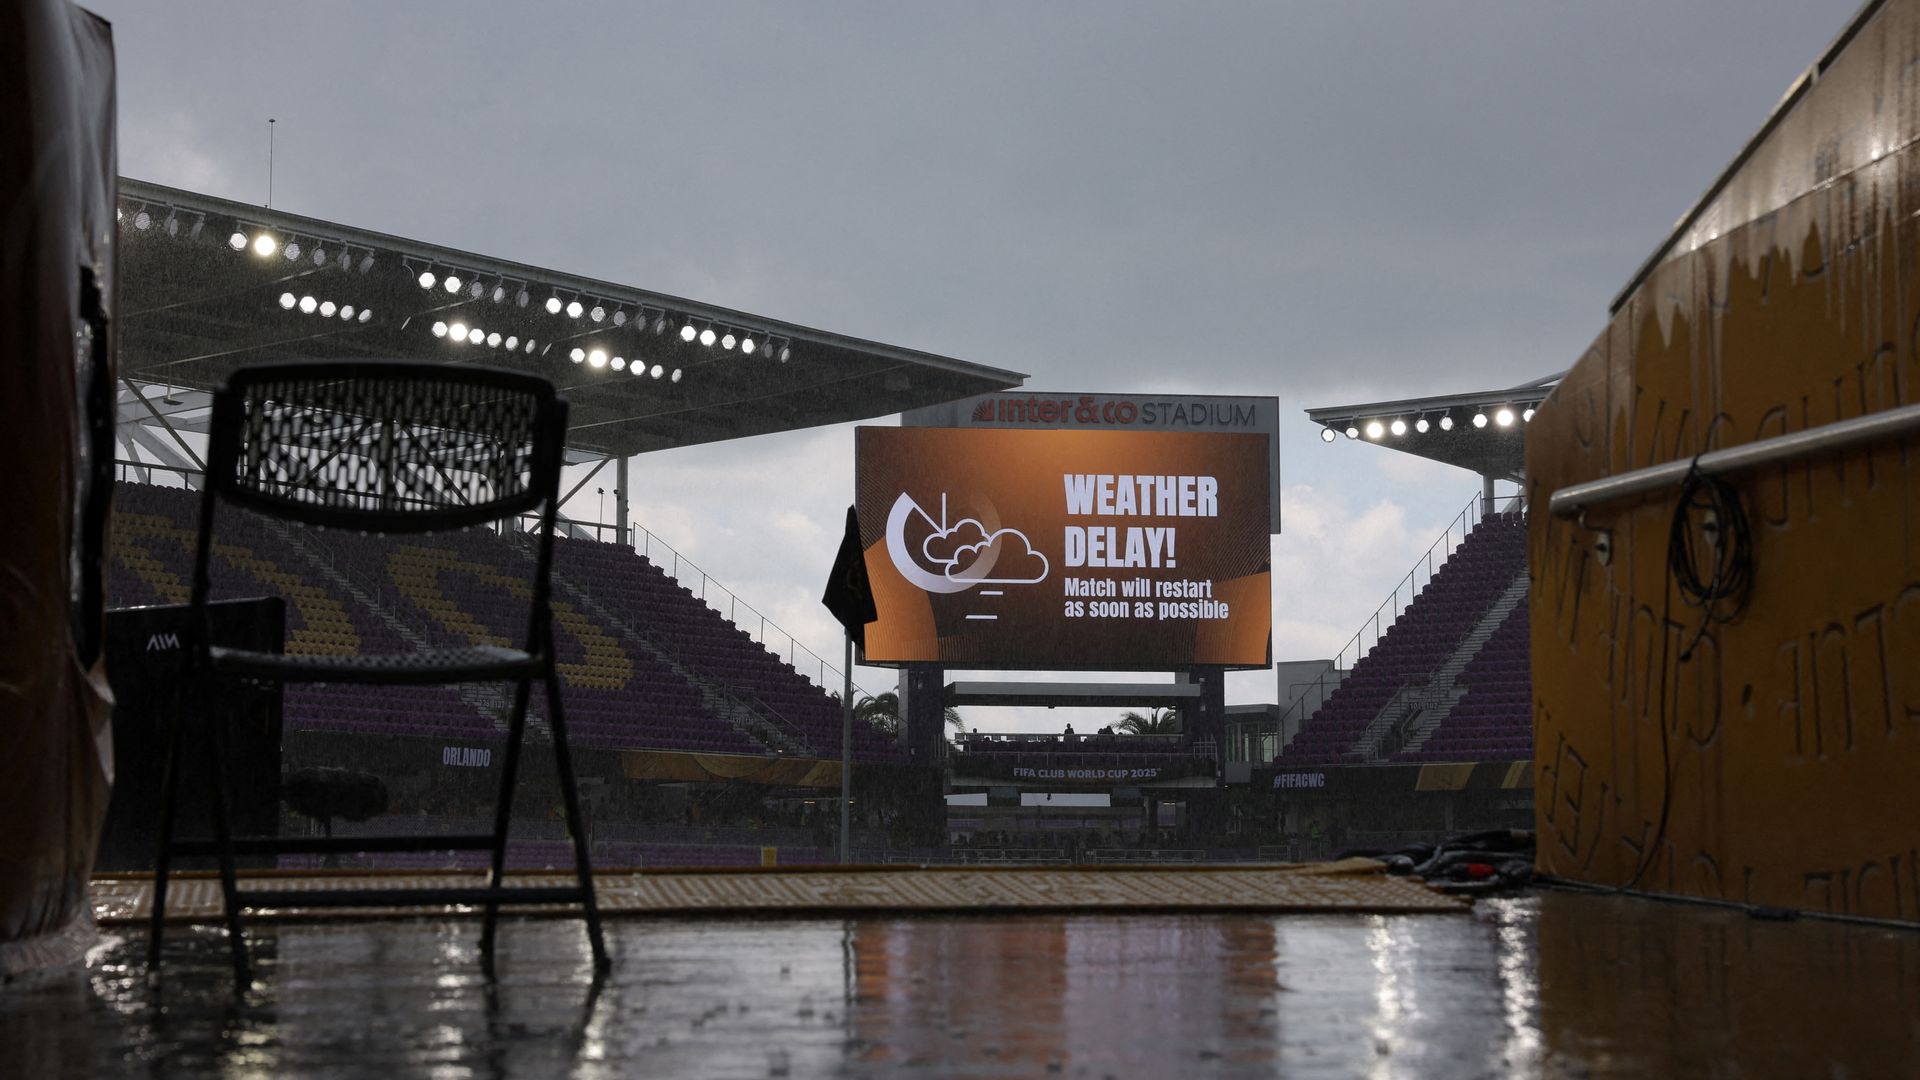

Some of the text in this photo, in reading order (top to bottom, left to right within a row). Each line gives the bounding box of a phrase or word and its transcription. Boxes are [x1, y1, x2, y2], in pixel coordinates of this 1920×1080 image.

[1142, 402, 1256, 426] STADIUM
[1064, 473, 1218, 517] WEATHER
[1064, 526, 1177, 569] DELAY!
[1064, 577, 1212, 598] Match will restart
[1064, 599, 1229, 621] as soon as possible
[442, 746, 491, 767] ORLANDO
[1013, 767, 1036, 778] FIFA
[1038, 769, 1065, 778] CLUB
[1067, 769, 1106, 779] WORLD
[1107, 769, 1128, 779] CUP
[1273, 772, 1326, 789] #FIFACWC
